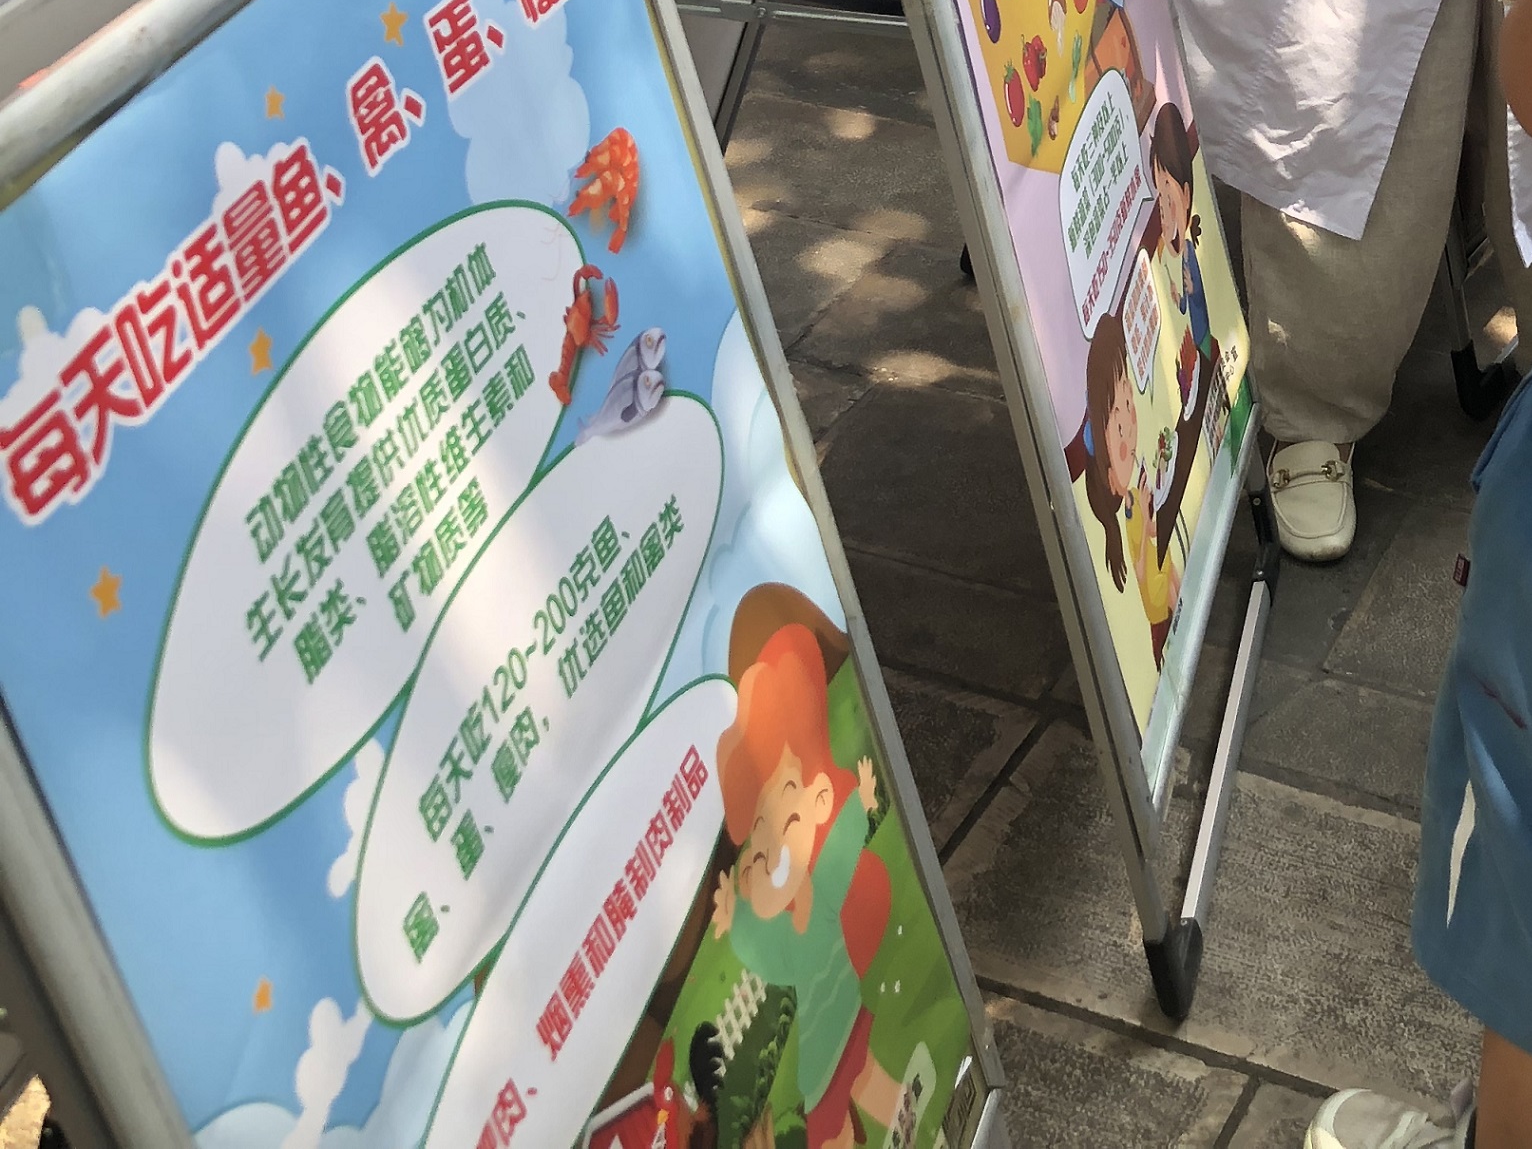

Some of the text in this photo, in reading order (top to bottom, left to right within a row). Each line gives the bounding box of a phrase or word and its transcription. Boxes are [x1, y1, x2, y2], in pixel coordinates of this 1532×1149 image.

[246, 243, 496, 563] 动物性食物能够为机体
[388, 478, 489, 632] 矿物质等
